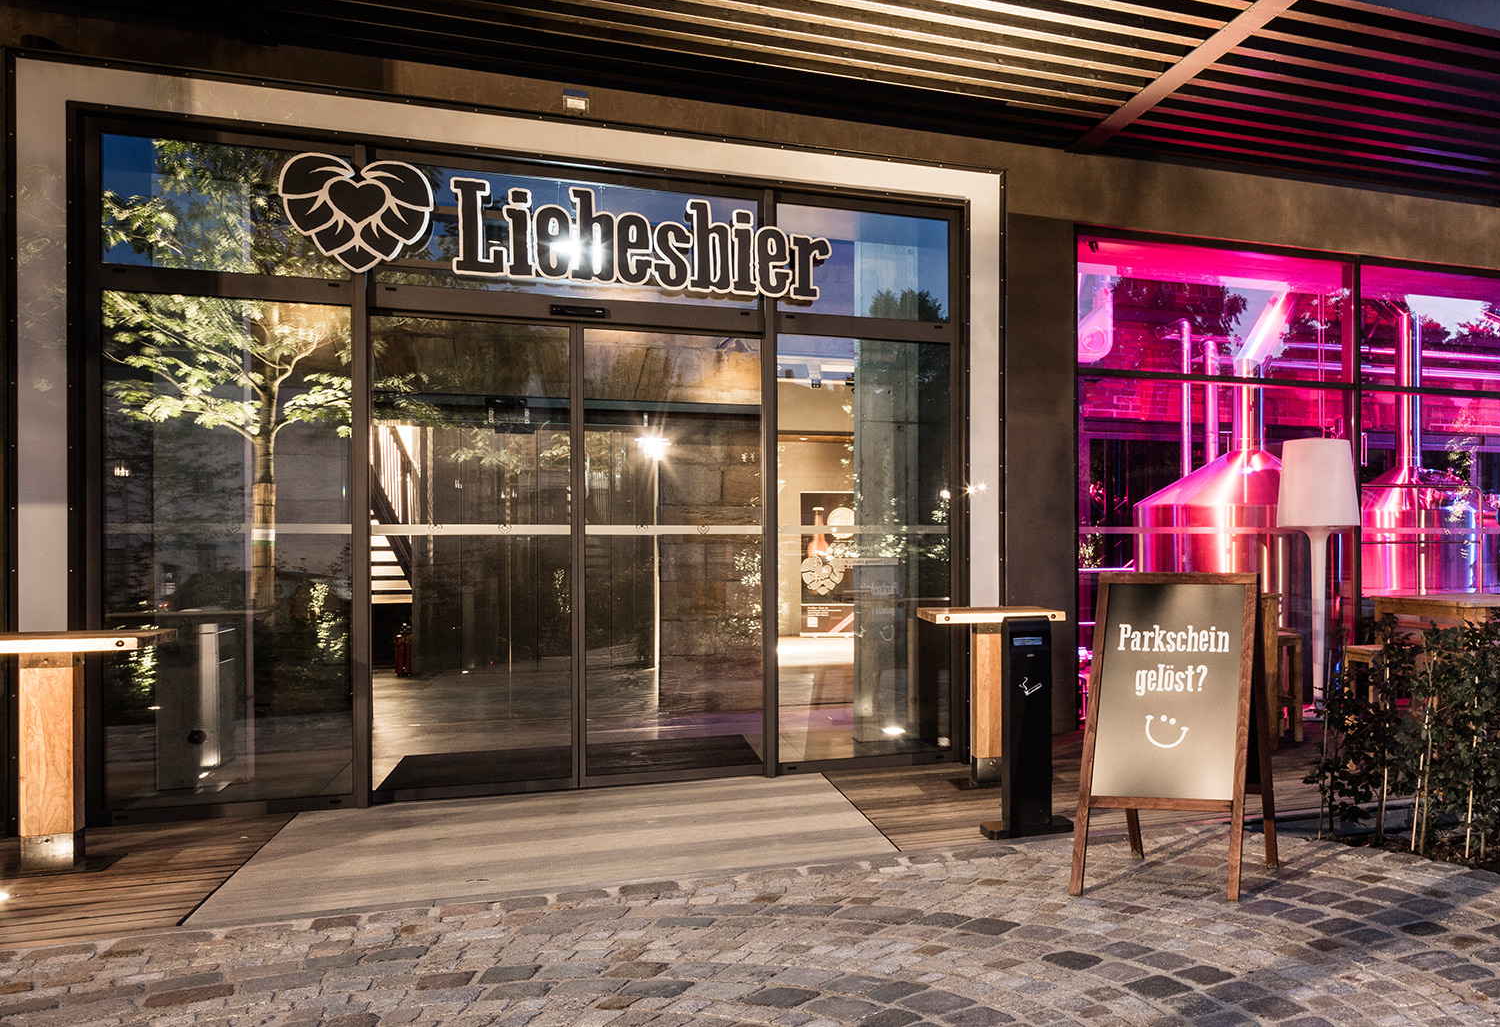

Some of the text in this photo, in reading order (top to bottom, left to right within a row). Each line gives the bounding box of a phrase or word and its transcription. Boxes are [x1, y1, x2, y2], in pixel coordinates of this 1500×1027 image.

[450, 176, 832, 300] Liebesbier
[1117, 623, 1230, 653] Parkschein
[1135, 663, 1208, 696] gelöst?
